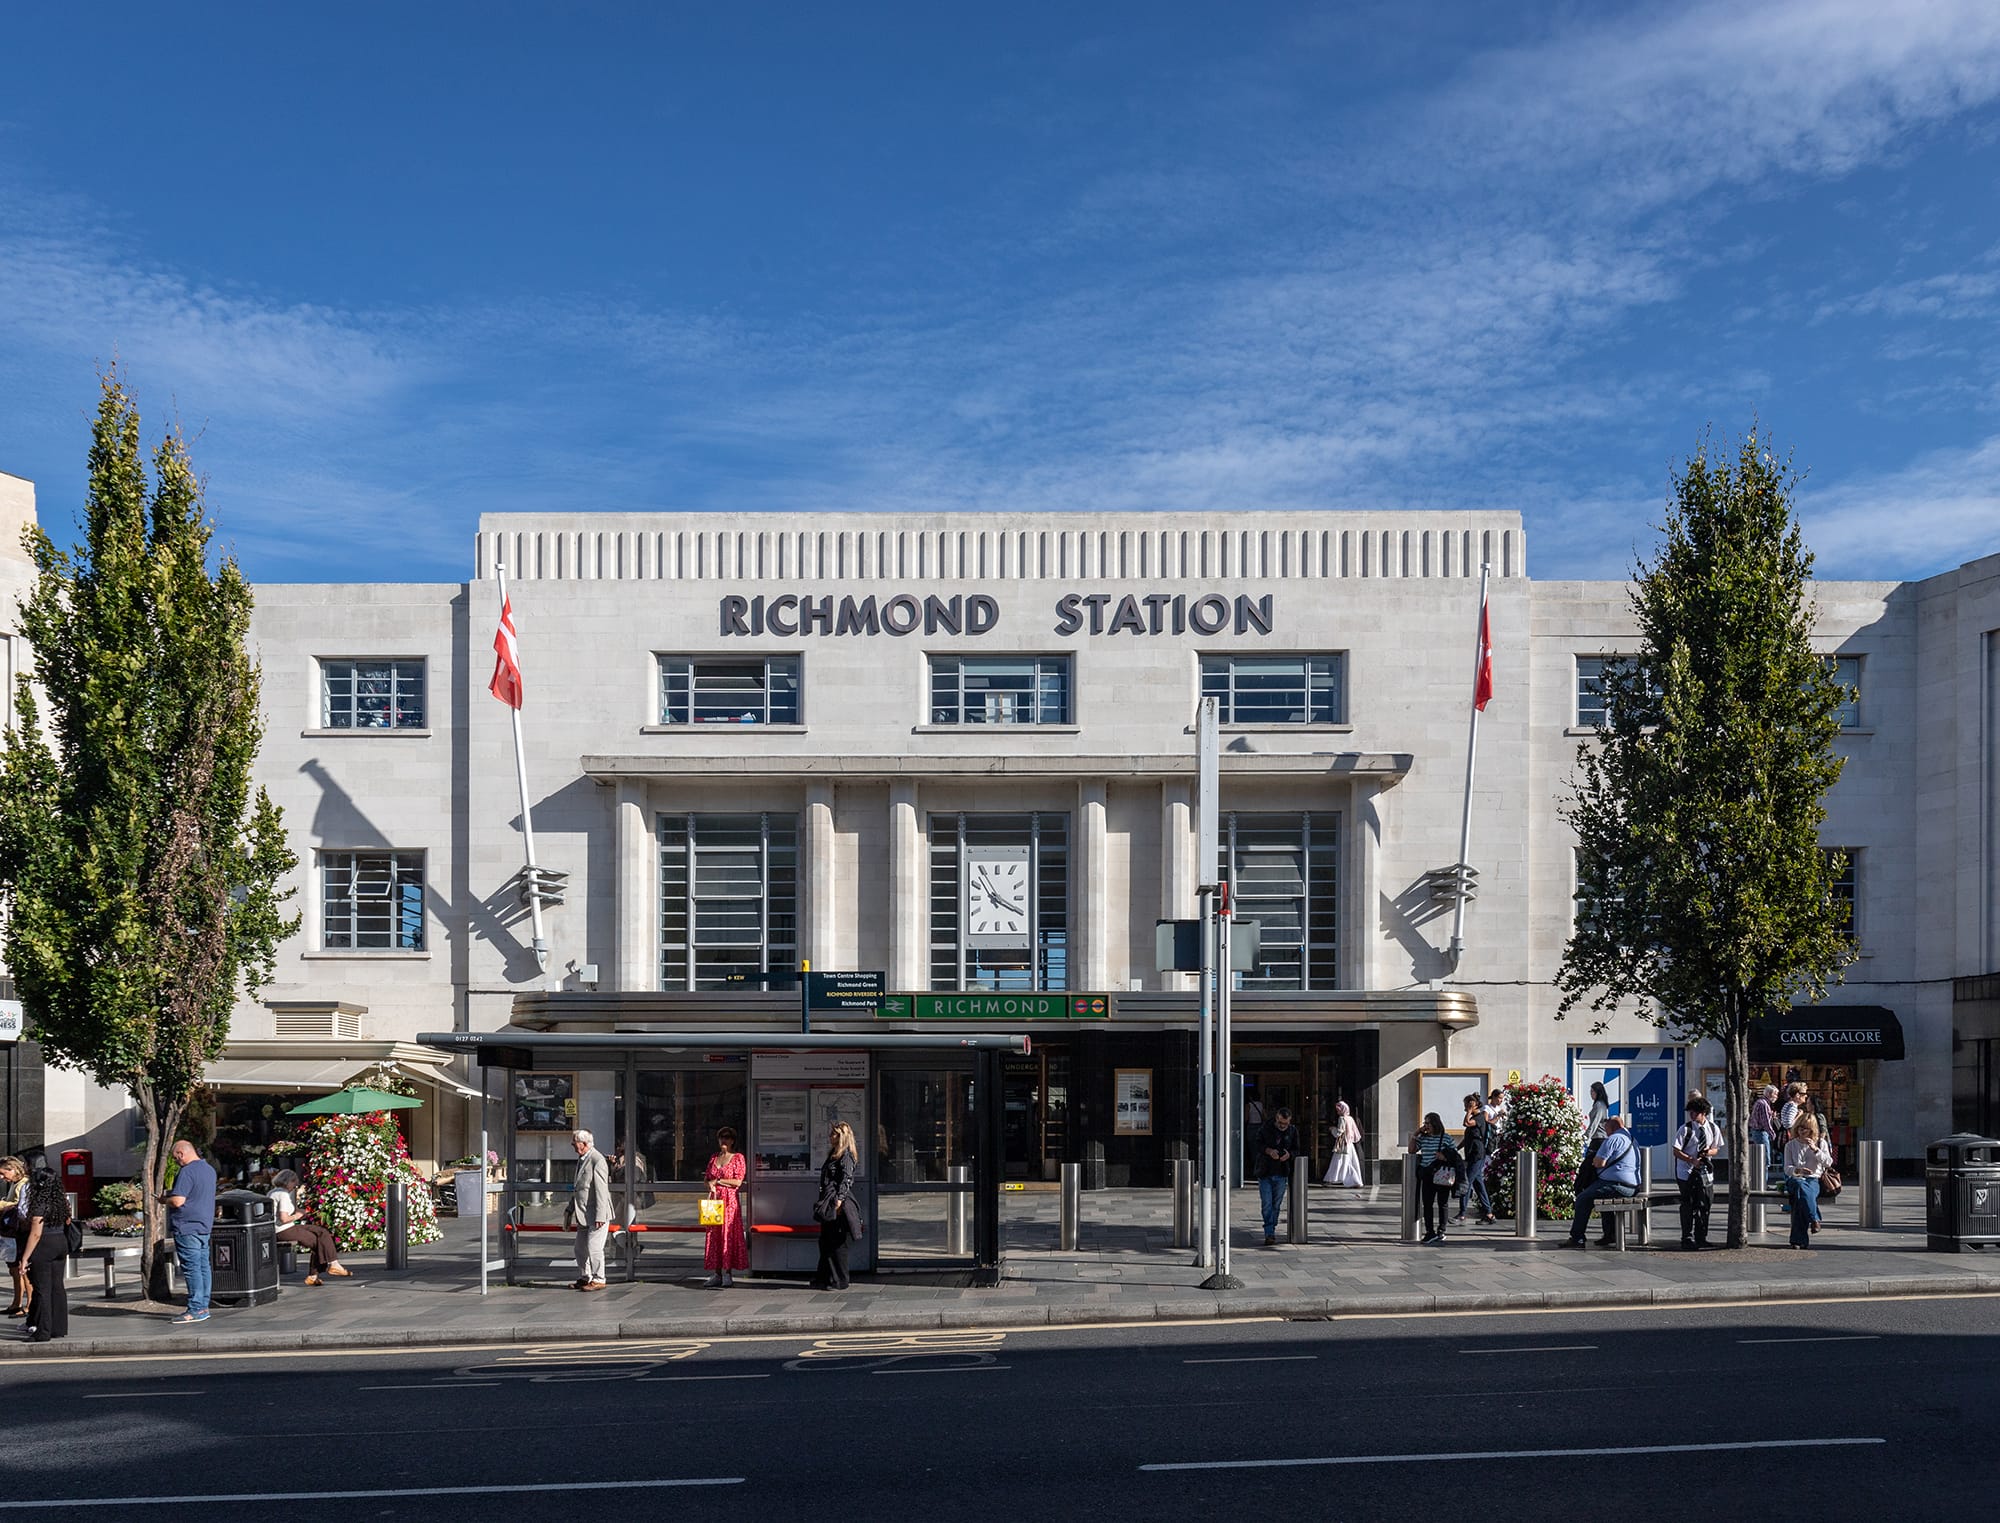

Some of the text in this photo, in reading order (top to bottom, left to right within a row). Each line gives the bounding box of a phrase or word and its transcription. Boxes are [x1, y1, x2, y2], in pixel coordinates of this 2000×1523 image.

[720, 593, 1273, 637] RICHMOND STATION
[935, 1000, 1049, 1014] RICHMOND
[1780, 1031, 1882, 1043] CARDS GALORE
[1635, 1093, 1660, 1109] Heidi
[430, 1342, 711, 1383] STOP
[781, 1332, 1008, 1372] BUS
